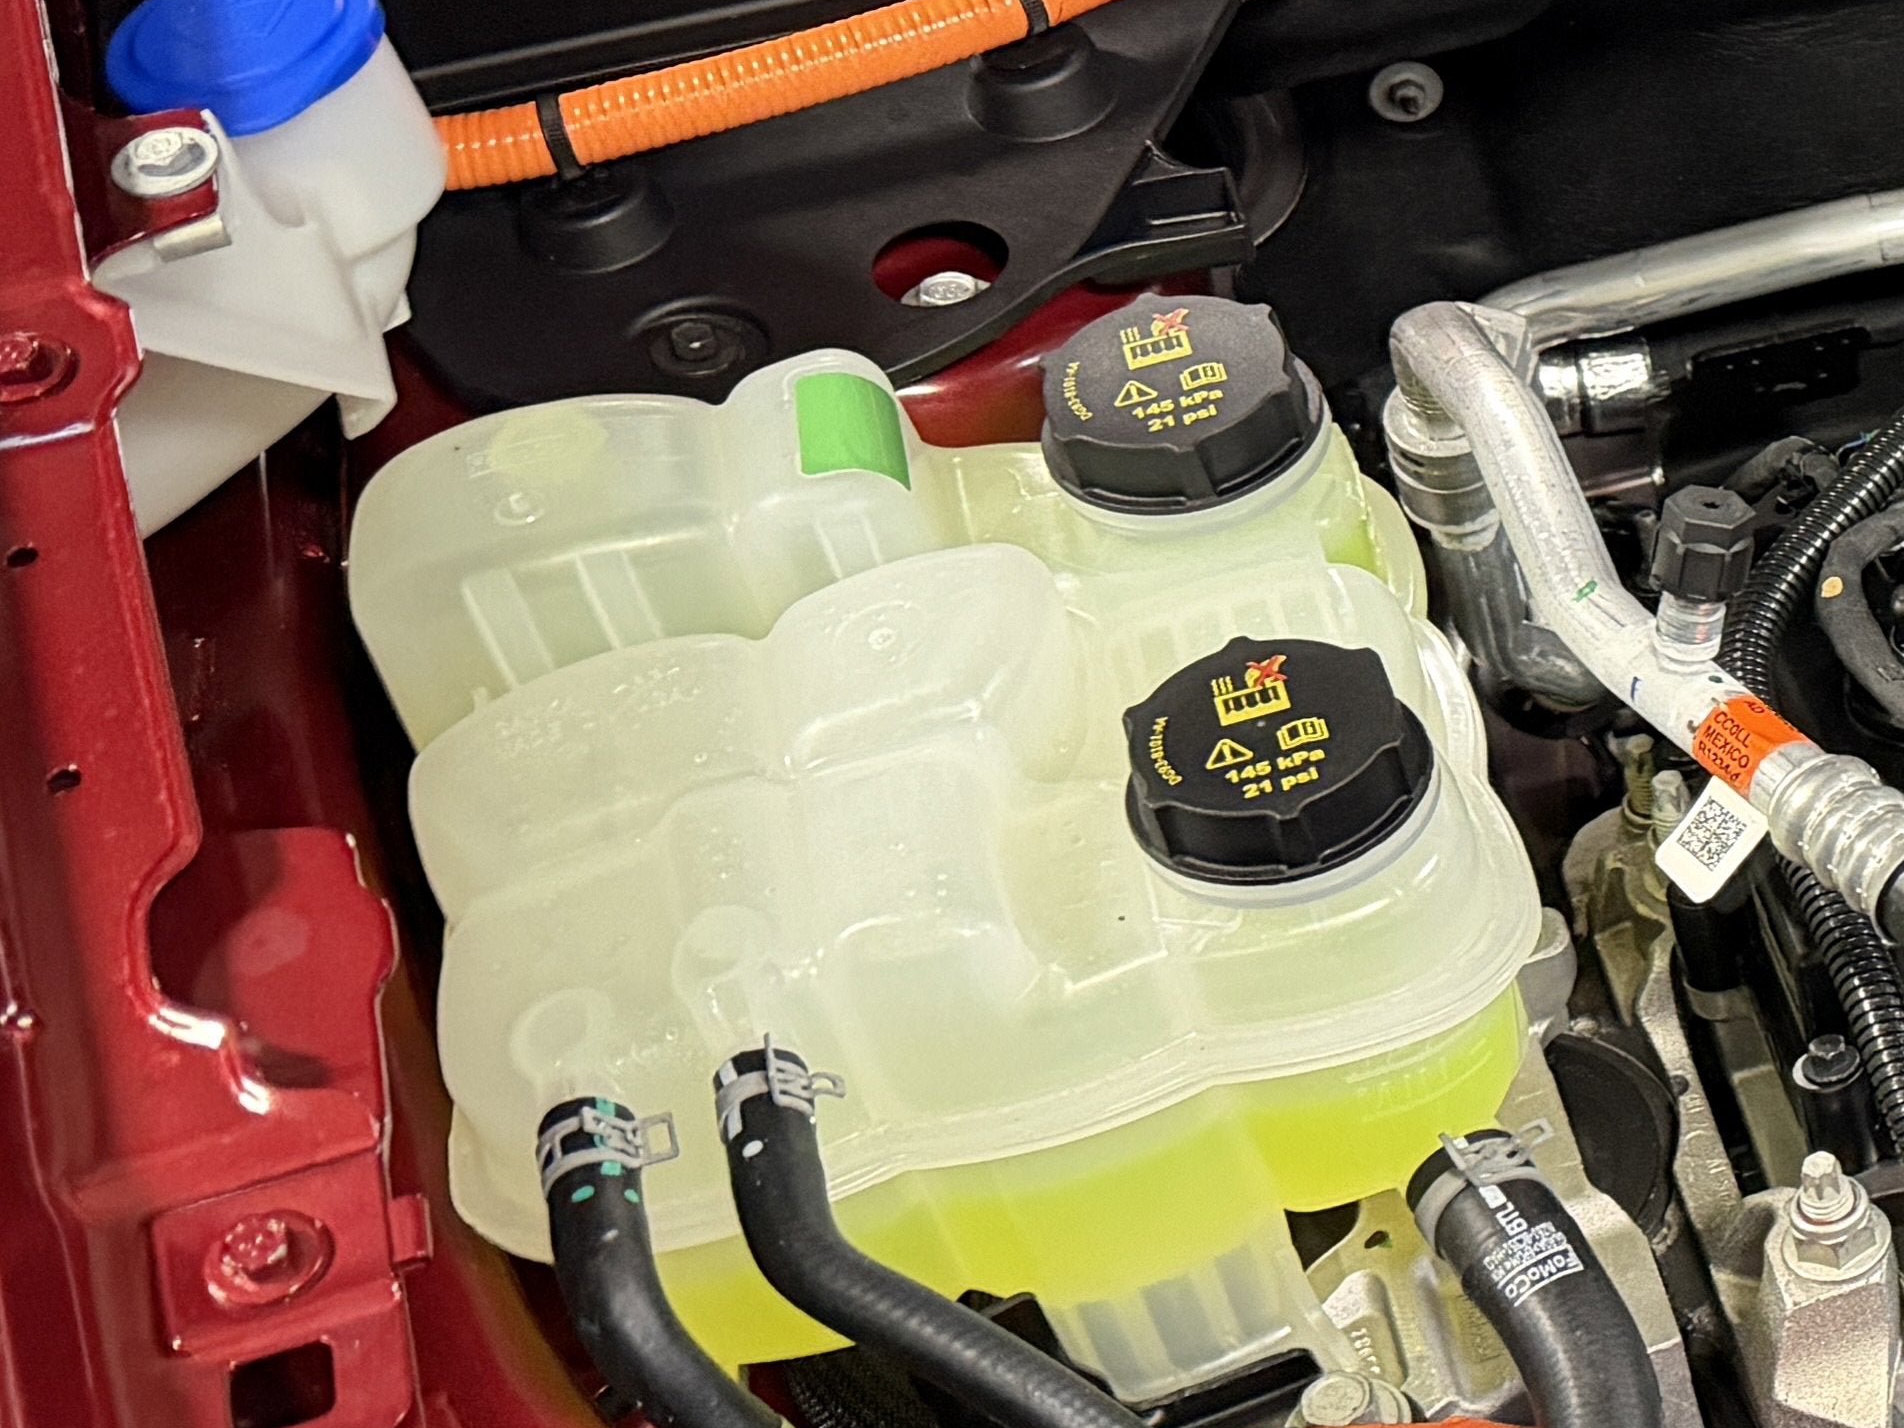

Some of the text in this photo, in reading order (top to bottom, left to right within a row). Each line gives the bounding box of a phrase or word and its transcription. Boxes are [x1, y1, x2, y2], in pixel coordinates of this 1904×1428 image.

[1132, 389, 1224, 419] 145 kPa
[1148, 404, 1218, 432] 21 psi
[1703, 725, 1750, 769] MEXICO
[1225, 749, 1326, 783] 145 kPa
[1242, 767, 1319, 799] 21 psi
[1504, 1248, 1581, 1299] FoMoCo
